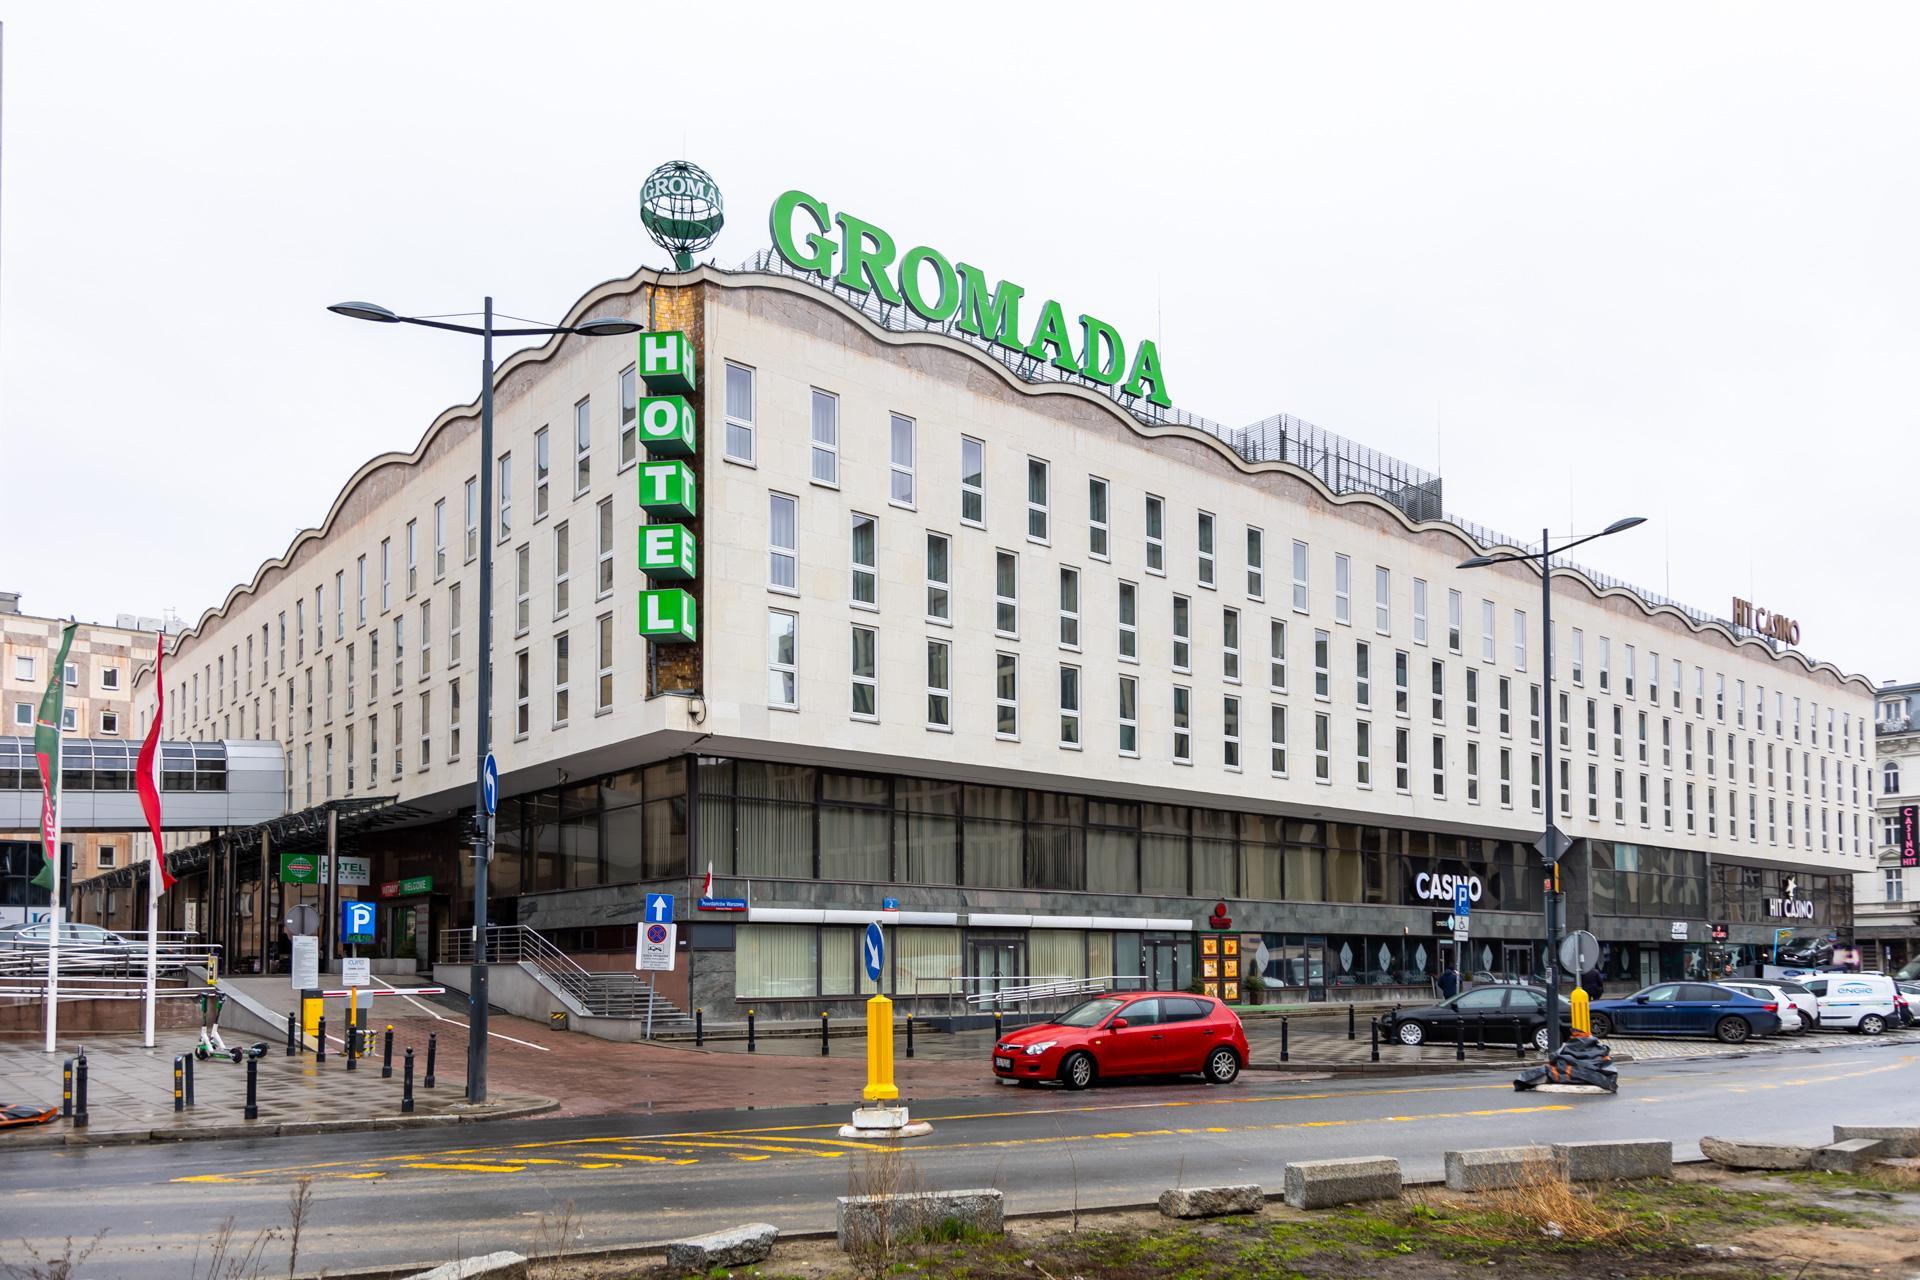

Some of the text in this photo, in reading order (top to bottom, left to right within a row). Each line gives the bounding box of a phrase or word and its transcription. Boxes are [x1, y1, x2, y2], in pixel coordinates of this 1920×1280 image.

[643, 177, 722, 209] GROMA
[769, 189, 1172, 408] GROMADA
[643, 336, 679, 630] HOTEL
[682, 338, 695, 636] HOTEL
[1732, 596, 1800, 646] HIT CASINO
[1903, 807, 1915, 857] CASINO
[1903, 857, 1917, 866] HIT
[1458, 887, 1467, 907] P
[1769, 898, 1815, 919] HIT CASINO
[353, 909, 370, 933] P
